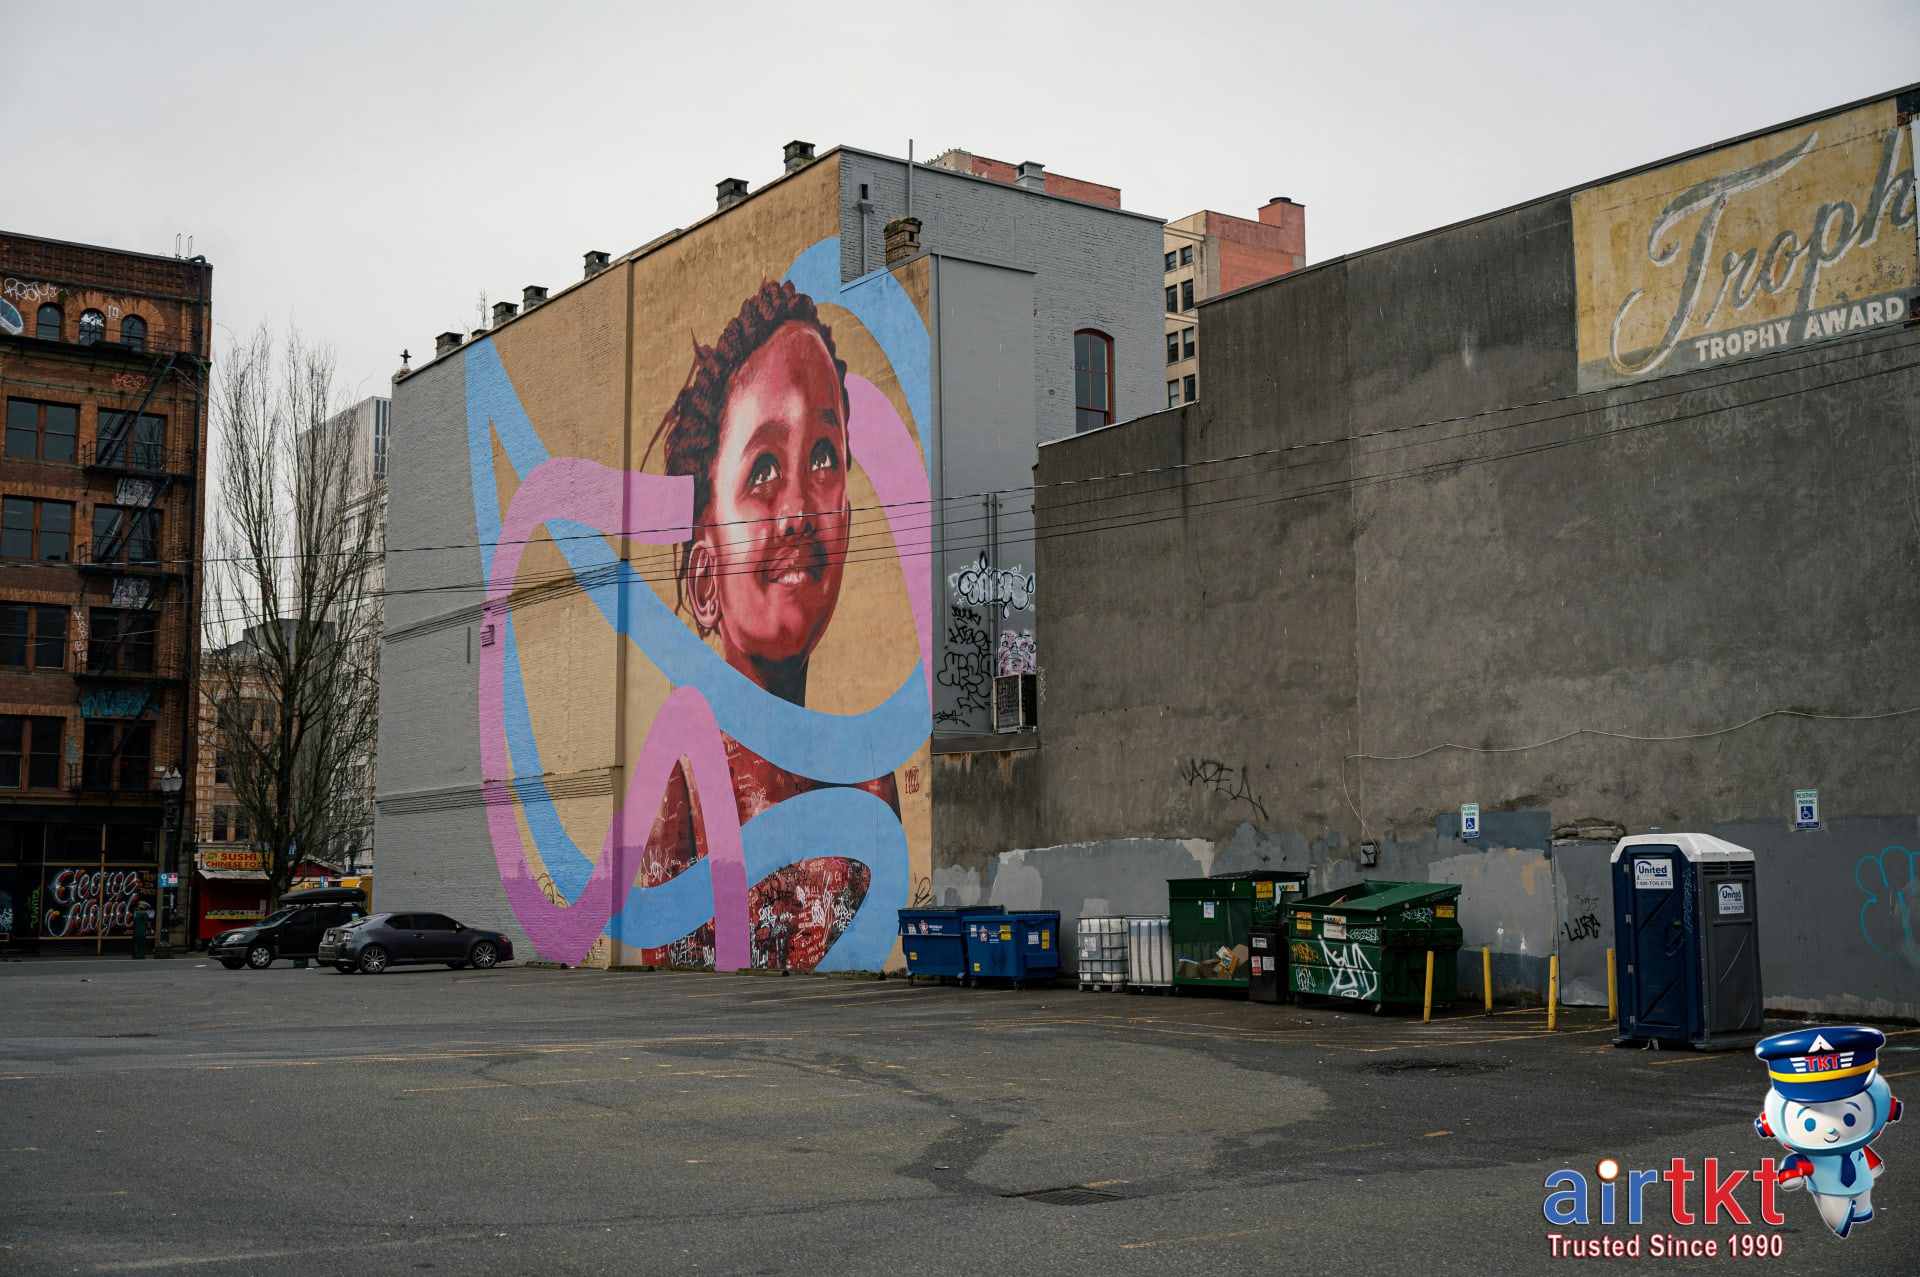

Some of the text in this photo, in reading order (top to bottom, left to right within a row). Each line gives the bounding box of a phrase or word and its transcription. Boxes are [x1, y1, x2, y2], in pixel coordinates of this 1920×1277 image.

[1695, 296, 1905, 362] TROPHY AWARD
[1638, 865, 1668, 874] United
[53, 868, 139, 904] George
[1722, 889, 1742, 899] United
